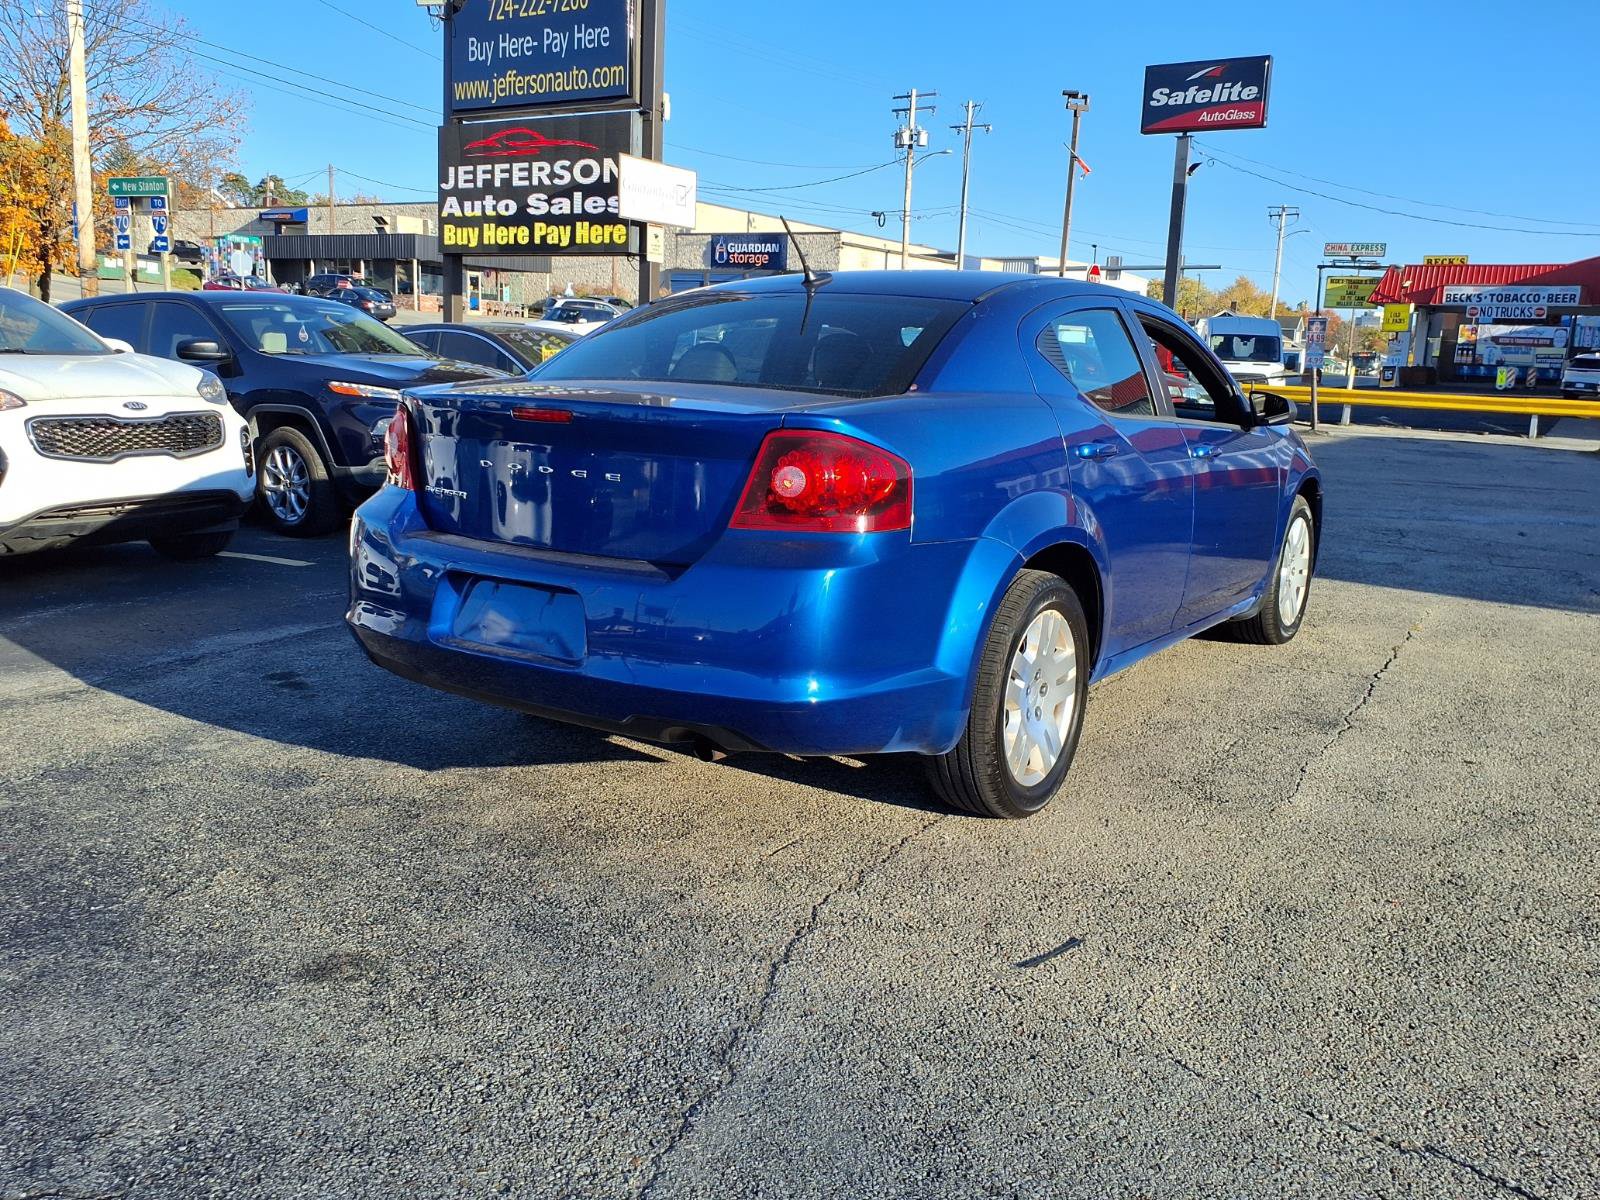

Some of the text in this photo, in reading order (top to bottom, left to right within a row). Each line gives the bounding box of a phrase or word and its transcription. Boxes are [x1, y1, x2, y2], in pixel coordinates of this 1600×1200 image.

[468, 24, 610, 65] Buy Here- Pay Here
[454, 65, 625, 103] www.jeffersonauto.com
[1150, 81, 1259, 107] Safelite
[1198, 109, 1256, 122] AutoGlass
[440, 157, 619, 190] JEFFERSON
[122, 181, 165, 192] New Stanton
[115, 198, 127, 207] EAST
[154, 199, 162, 207] TO
[441, 191, 619, 217] Auto Sales
[117, 216, 129, 229] 70
[153, 217, 167, 230] 79
[443, 221, 627, 248] Buy Here Pay Here
[728, 242, 780, 253] GUARDIAN
[729, 253, 769, 267] storage
[1426, 257, 1466, 265] BECK'S
[1445, 293, 1577, 304] BECK'S TOBACCO BEER
[1480, 306, 1494, 317] NO
[1495, 306, 1533, 318] TRUCKS
[480, 459, 621, 482] DODGE
[425, 485, 467, 499] AVENGER
